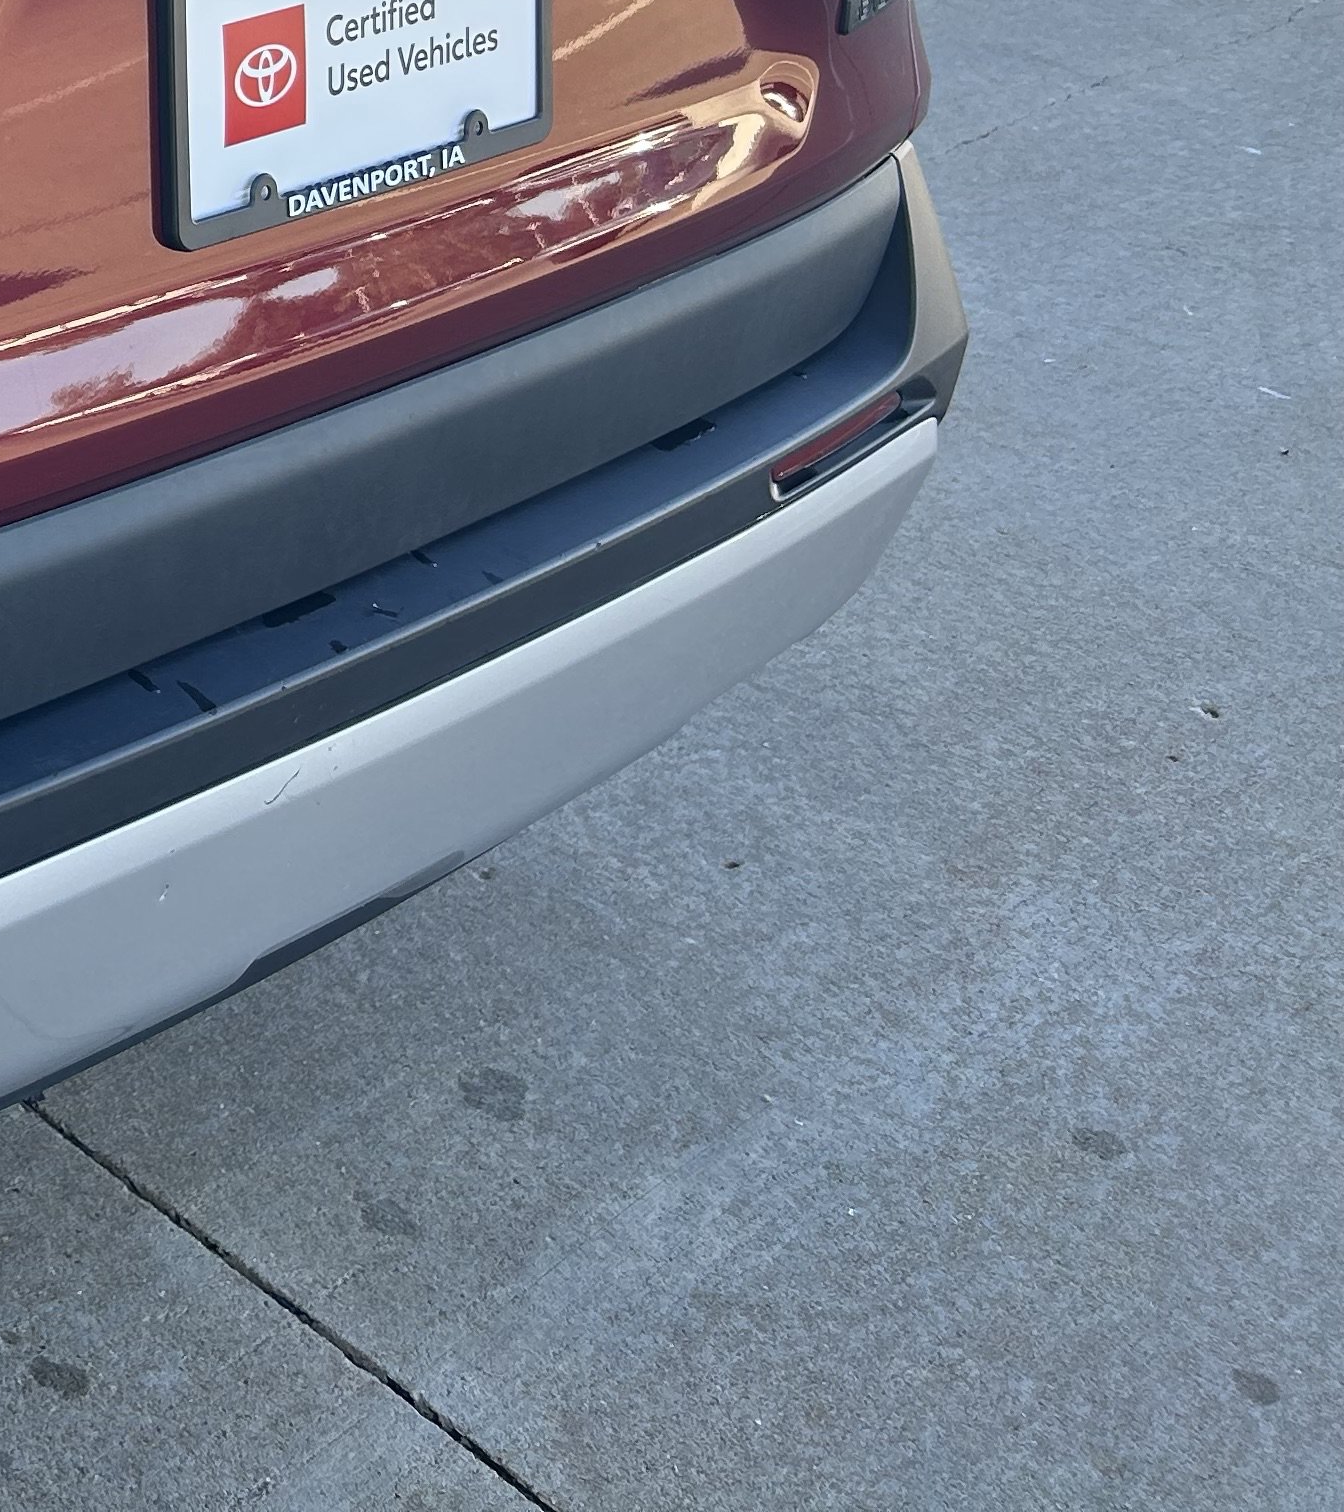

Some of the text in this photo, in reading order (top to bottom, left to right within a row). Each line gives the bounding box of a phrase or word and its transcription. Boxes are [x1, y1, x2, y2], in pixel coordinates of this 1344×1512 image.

[327, 26, 500, 97] Used Vehicles
[287, 145, 467, 218] DAVENPORT, IA
